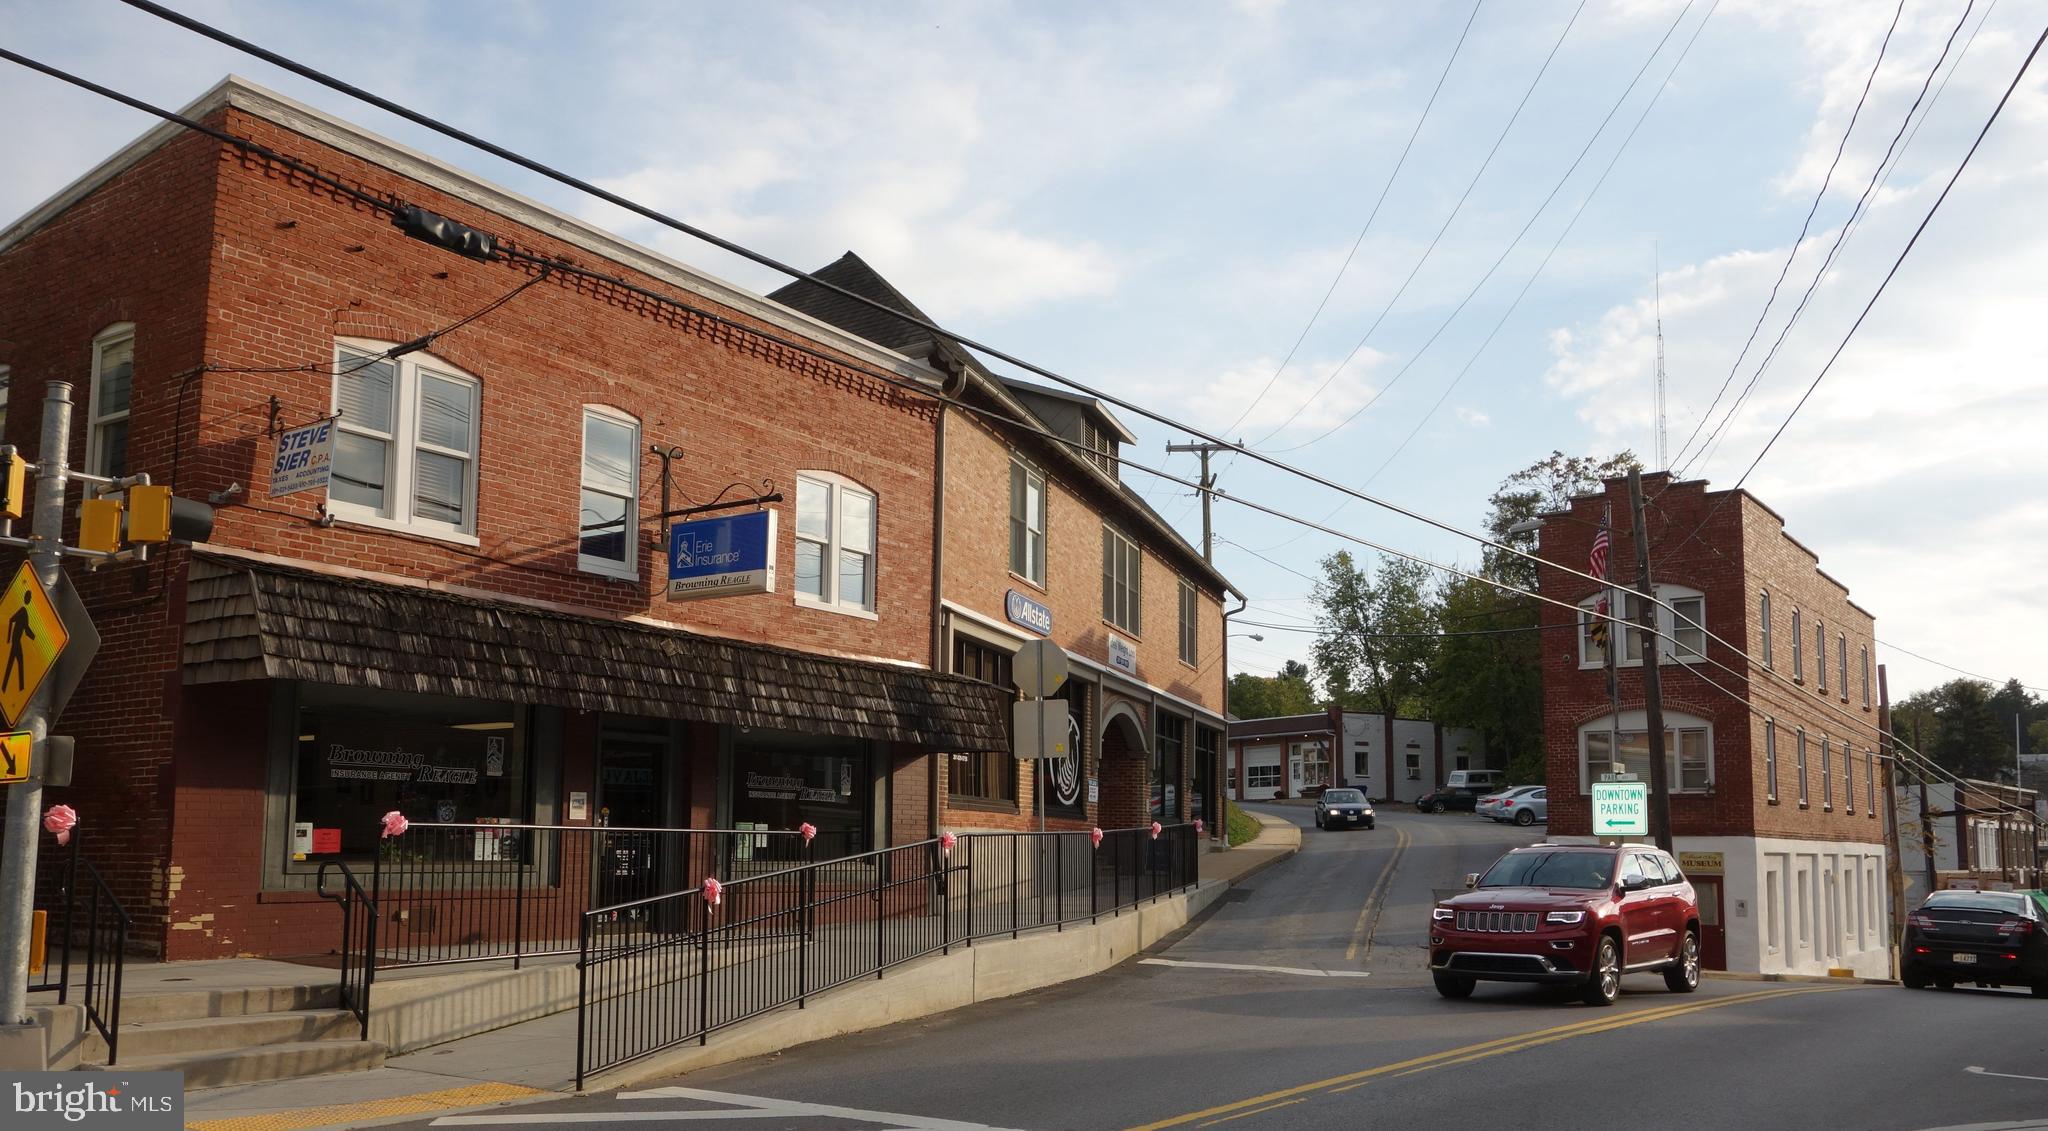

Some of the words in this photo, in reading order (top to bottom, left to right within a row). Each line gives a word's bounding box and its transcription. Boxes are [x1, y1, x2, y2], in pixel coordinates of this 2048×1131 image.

[279, 424, 331, 452] STEVE
[274, 449, 312, 474] SIER
[272, 475, 289, 484] TAXES
[296, 465, 329, 478] ACCOUNTING
[695, 540, 713, 554] Erie
[695, 551, 740, 566] Insurance
[675, 577, 719, 591] Browning
[1021, 602, 1050, 630] Allstate
[328, 744, 424, 768] Browning
[331, 769, 378, 779] INSURANCE
[379, 771, 412, 781] AGENCY
[417, 764, 478, 784] REAGLE
[1596, 789, 1643, 801] DOWNTOWN
[1600, 803, 1639, 815] PARKING
